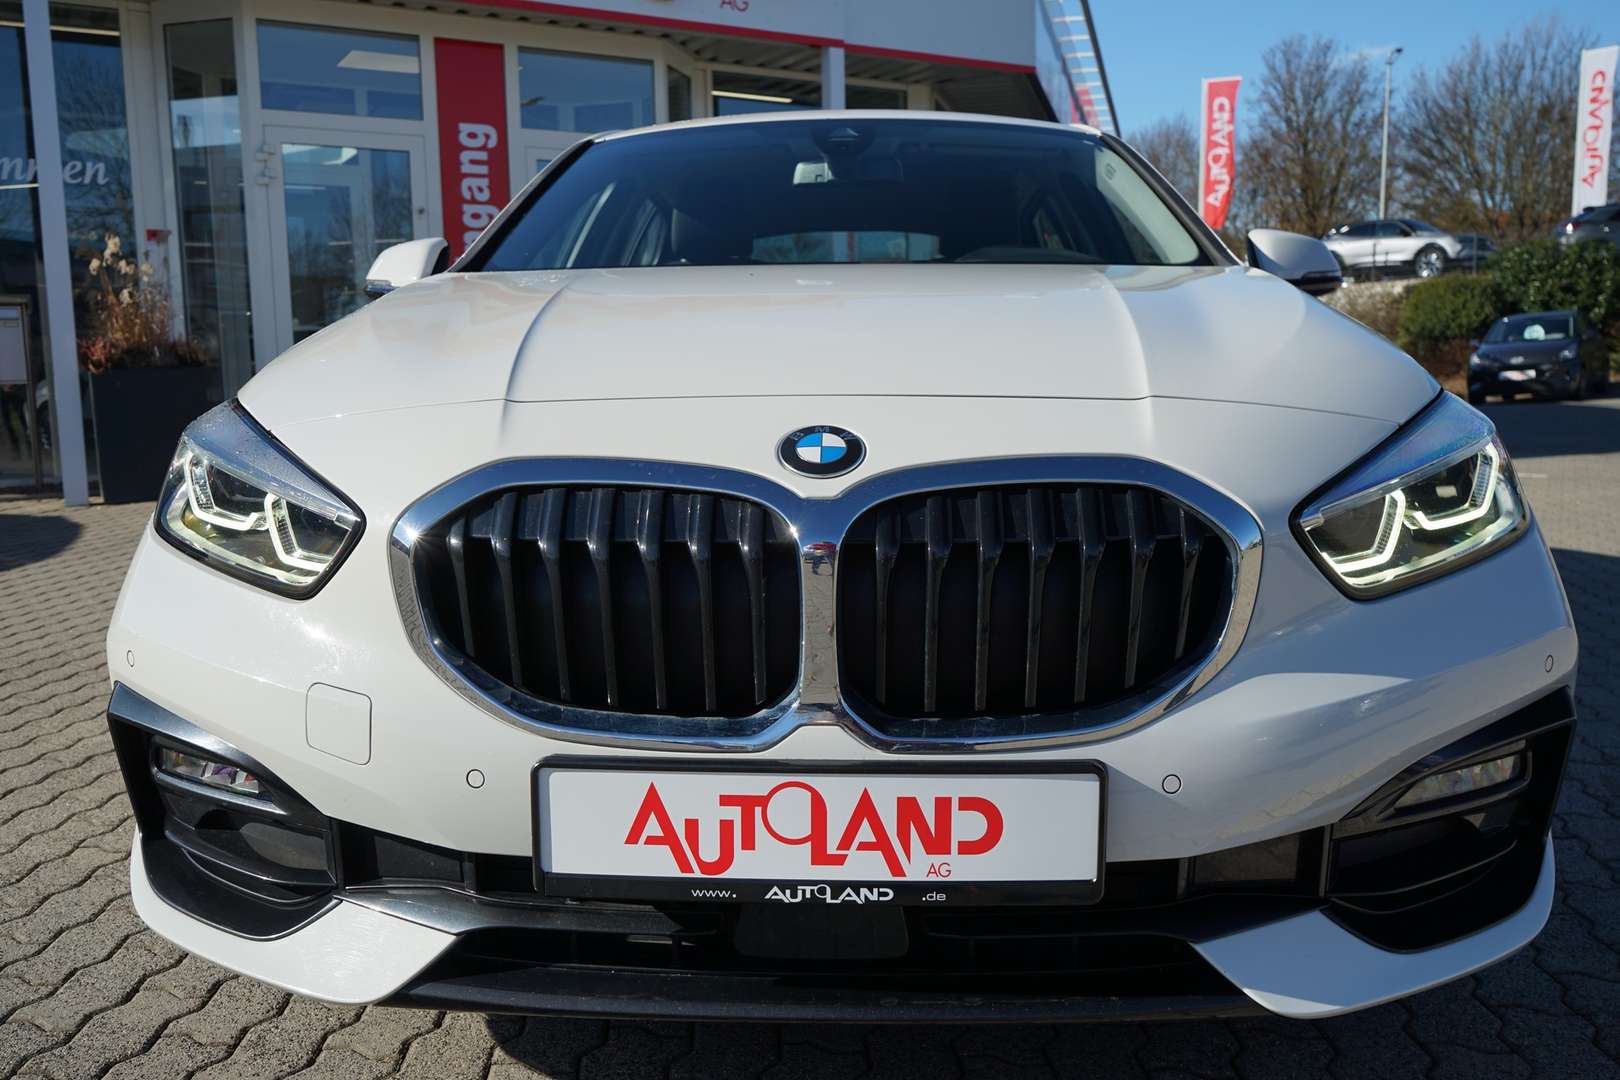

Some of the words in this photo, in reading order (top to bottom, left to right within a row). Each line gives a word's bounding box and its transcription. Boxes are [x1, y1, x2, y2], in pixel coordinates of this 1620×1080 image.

[1206, 96, 1234, 206] AUTOLAND
[624, 781, 1003, 877] AUTOLAND
[691, 888, 737, 898] www.
[764, 884, 894, 904] AUTOLAND
[922, 890, 947, 902] .de
[926, 862, 952, 878] AG
